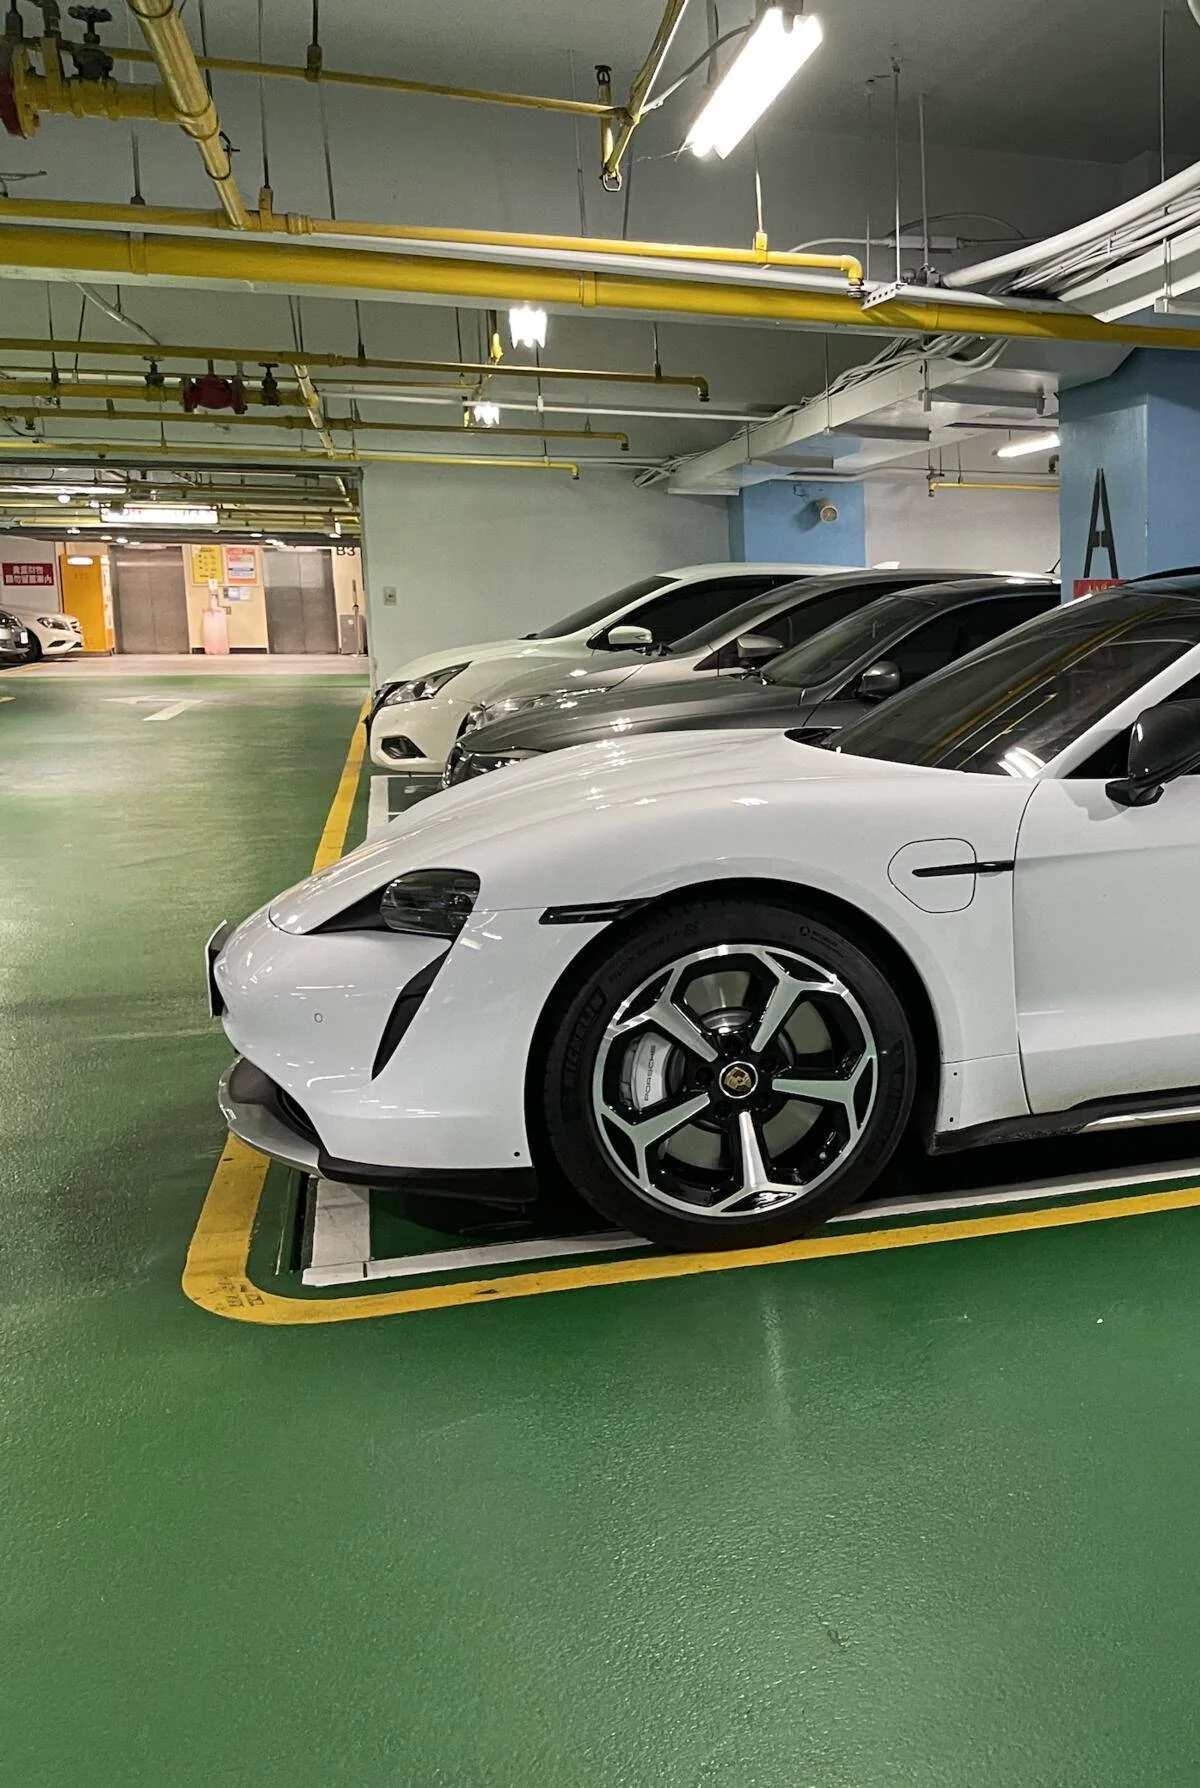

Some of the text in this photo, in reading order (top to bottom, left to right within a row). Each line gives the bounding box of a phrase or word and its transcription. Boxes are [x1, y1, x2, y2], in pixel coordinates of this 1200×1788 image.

[336, 545, 355, 557] B3
[1083, 467, 1119, 578] A
[644, 1044, 656, 1102] PORSCHE
